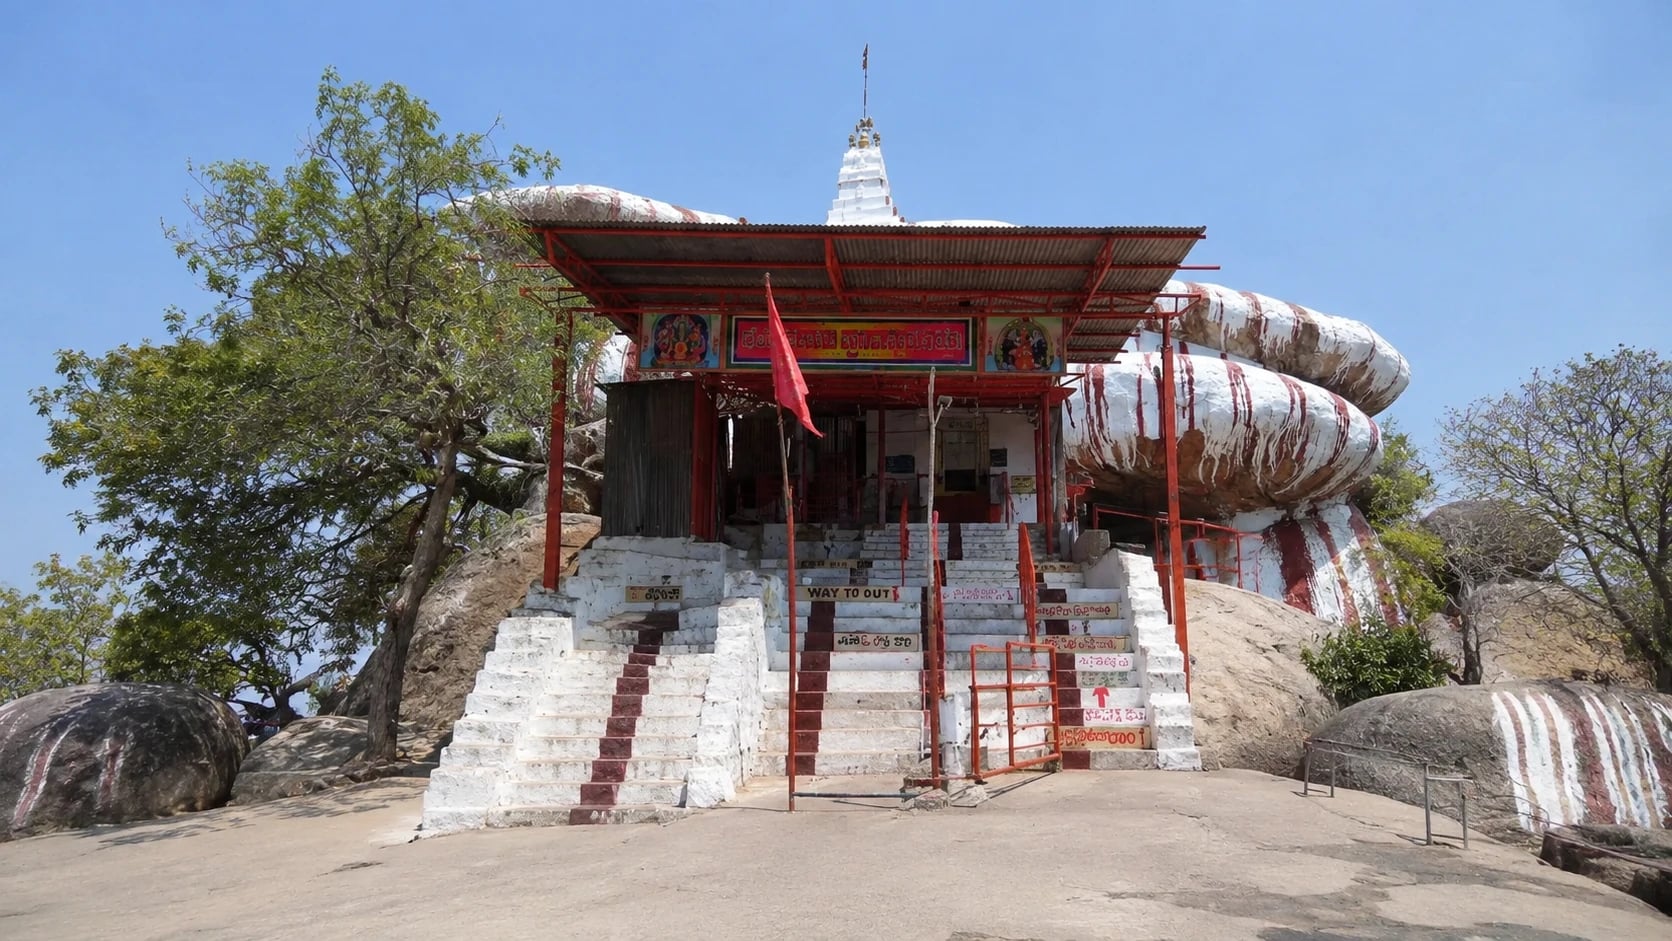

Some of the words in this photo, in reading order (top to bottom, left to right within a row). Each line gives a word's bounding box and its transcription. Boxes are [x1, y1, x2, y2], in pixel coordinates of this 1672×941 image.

[808, 587, 839, 598] WAY
[844, 588, 859, 598] TO
[864, 588, 890, 599] OUT
